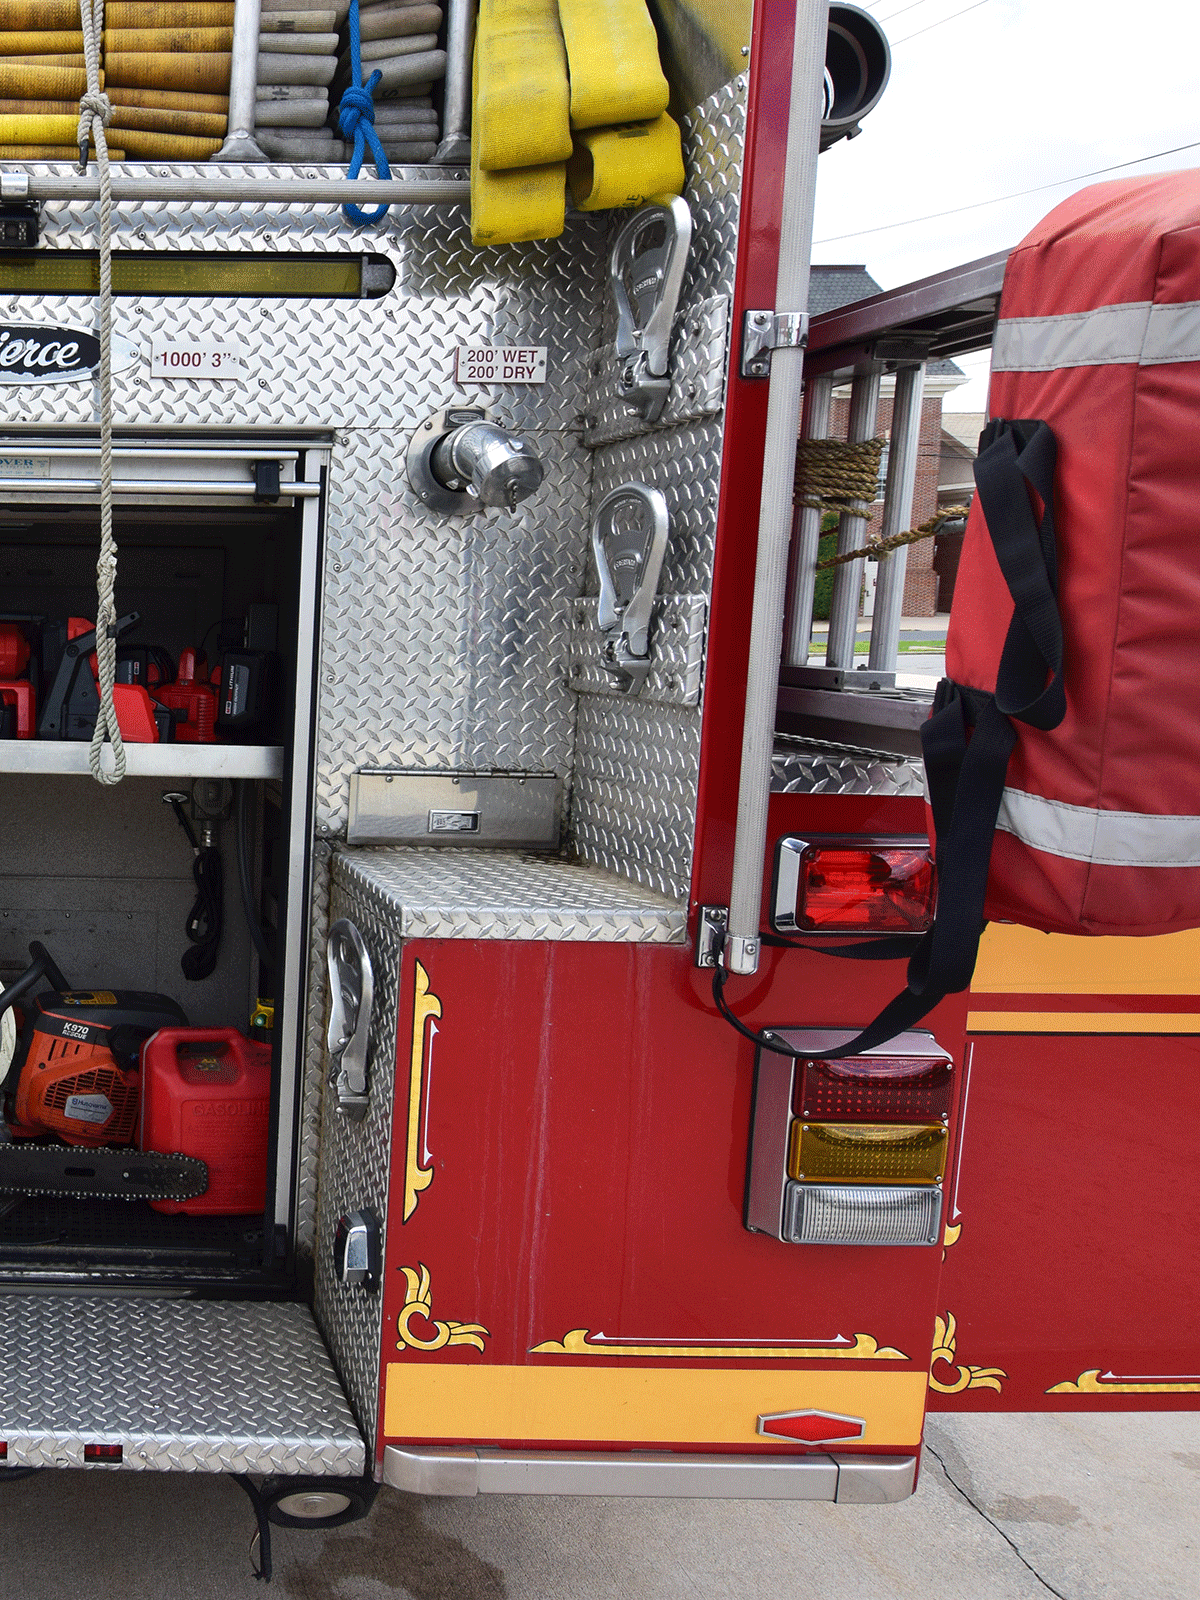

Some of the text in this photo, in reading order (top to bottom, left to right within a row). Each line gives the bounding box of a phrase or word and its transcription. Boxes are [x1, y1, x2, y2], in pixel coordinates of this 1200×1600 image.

[160, 352, 206, 367] 1000'
[467, 350, 538, 363] 200' WET
[467, 366, 536, 379] 200' DRY
